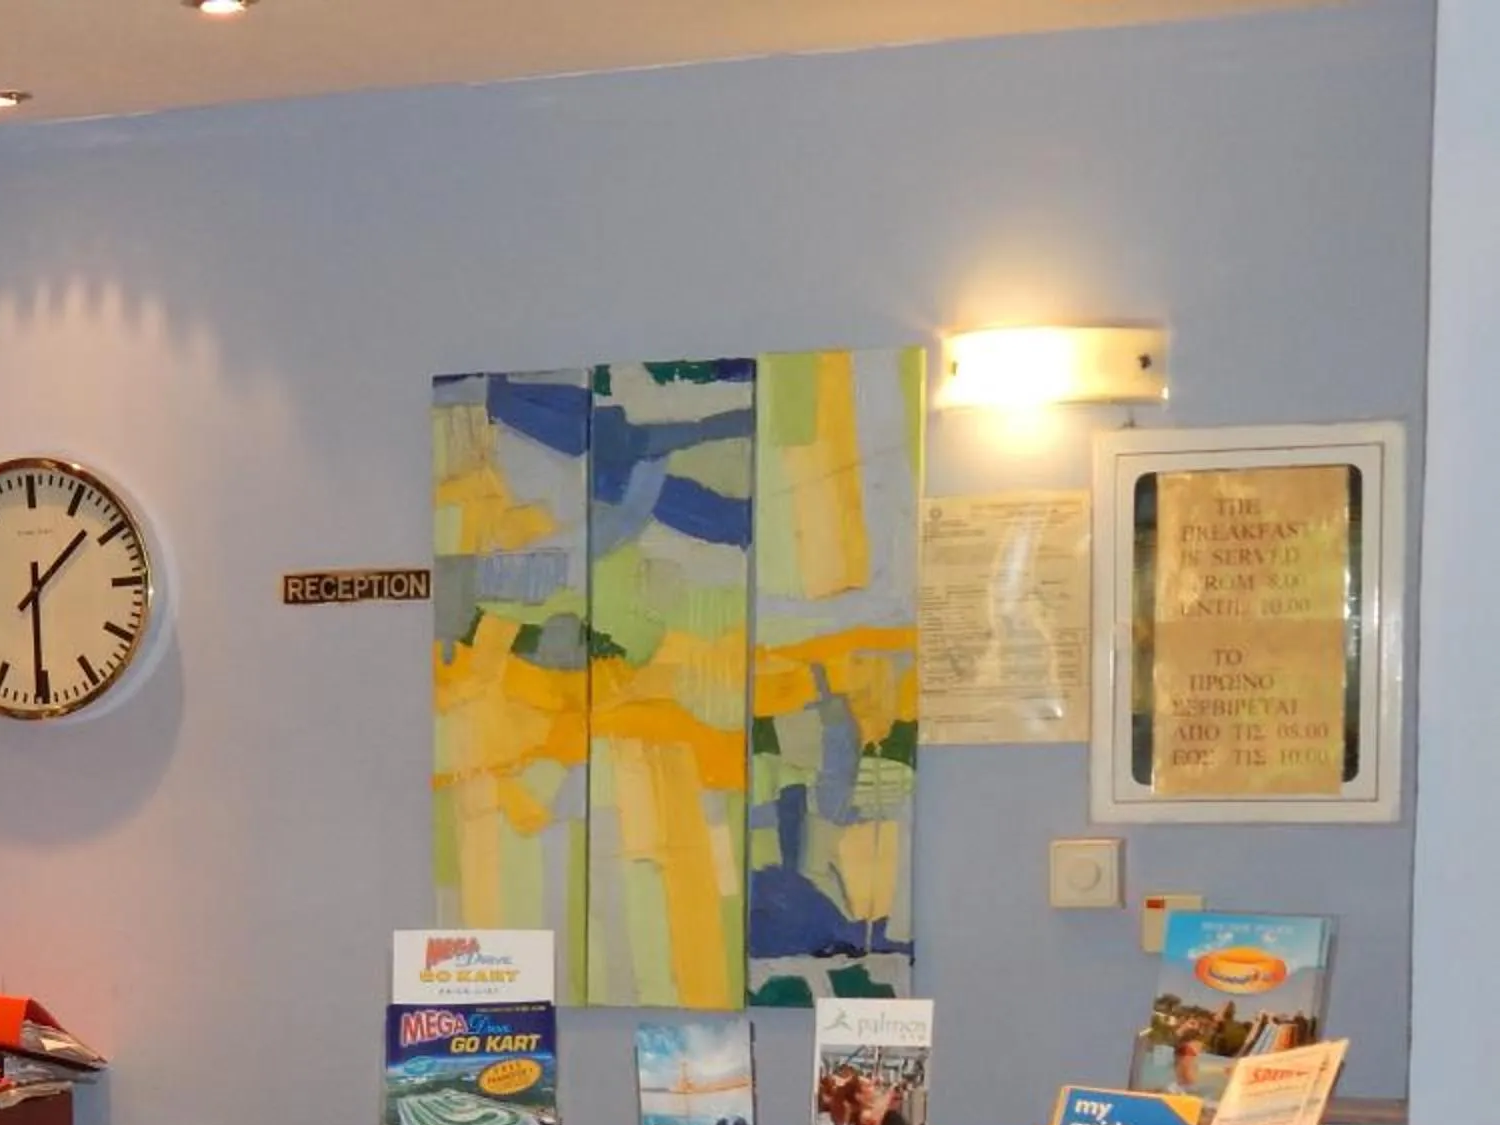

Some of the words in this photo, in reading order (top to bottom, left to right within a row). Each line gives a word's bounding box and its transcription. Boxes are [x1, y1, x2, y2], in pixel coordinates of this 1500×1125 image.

[286, 573, 427, 600] RECEPTION
[1195, 573, 1254, 592] ROM
[400, 1009, 468, 1047] MEGA
[450, 1034, 481, 1053] GO
[485, 1034, 542, 1052] KART
[1075, 1098, 1114, 1121] my
